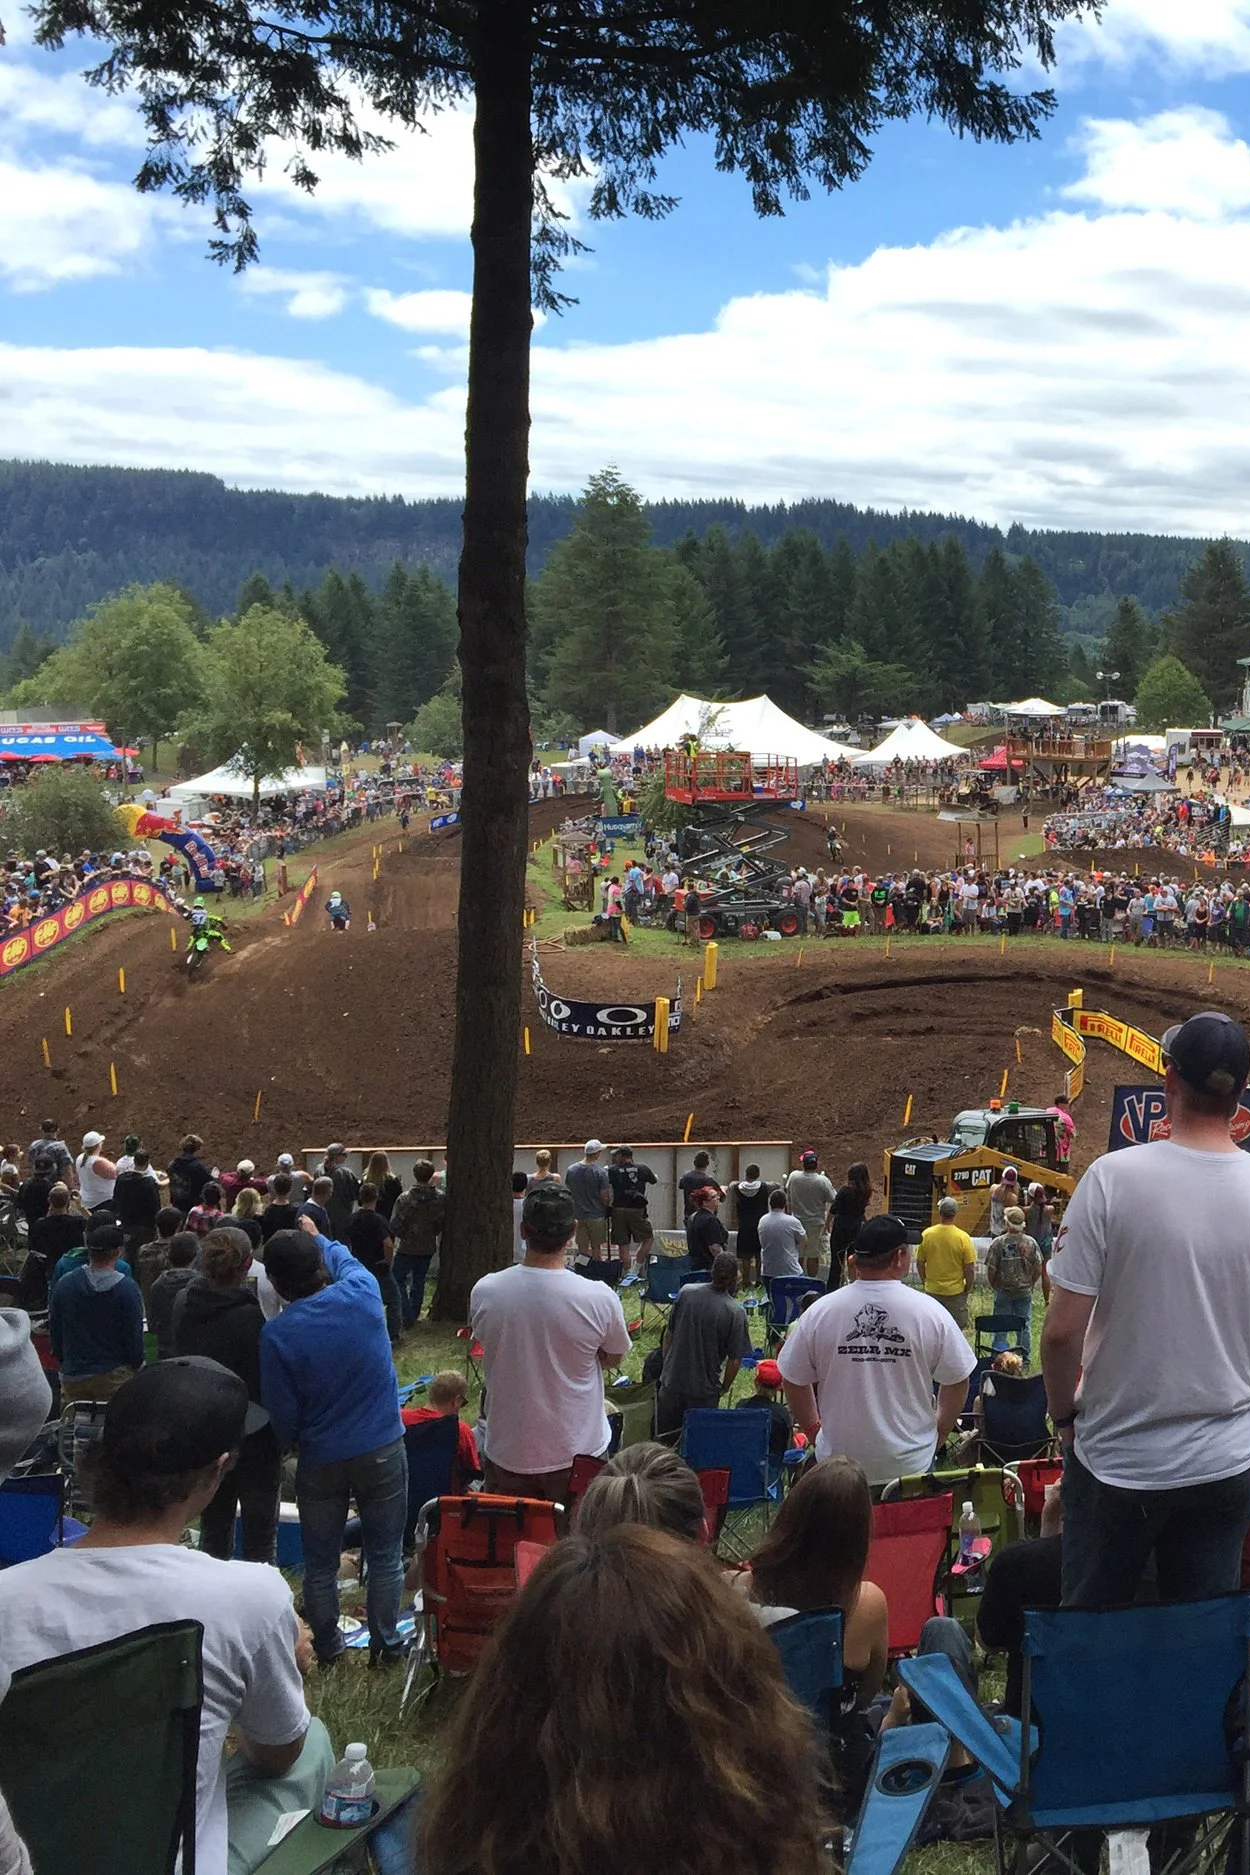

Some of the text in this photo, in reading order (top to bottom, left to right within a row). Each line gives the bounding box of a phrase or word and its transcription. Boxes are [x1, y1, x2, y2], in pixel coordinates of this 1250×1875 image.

[0, 735, 96, 745] UCAS OIL
[586, 1025, 655, 1036] OAKLEY
[1080, 1015, 1123, 1042] PIRELLI
[1129, 1034, 1156, 1064] PIRELLI
[1124, 1092, 1168, 1142] VP
[904, 1164, 917, 1175] CAT
[971, 1168, 993, 1187] CAT
[838, 1346, 881, 1355] ZERR
